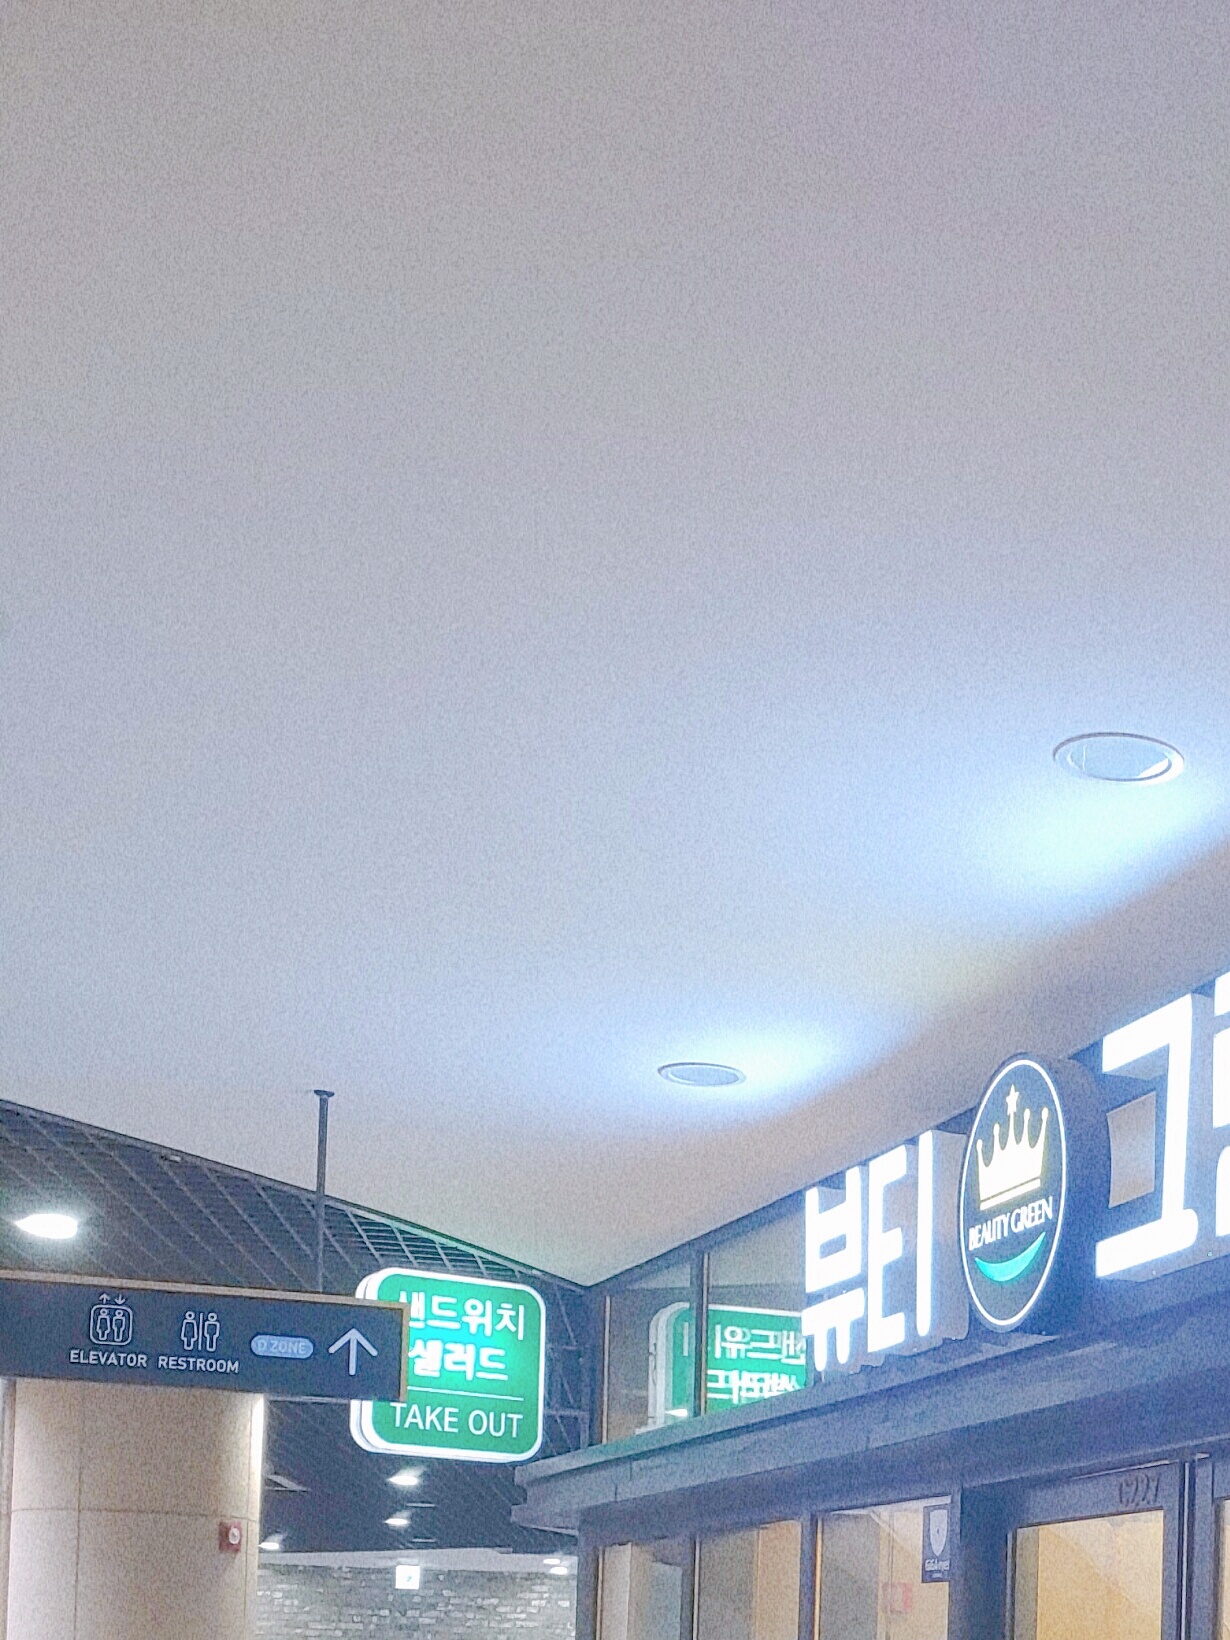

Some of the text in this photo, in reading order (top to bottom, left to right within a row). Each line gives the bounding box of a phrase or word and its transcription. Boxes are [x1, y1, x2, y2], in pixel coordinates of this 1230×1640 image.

[969, 1196, 1053, 1251] BEAUTY GREEN
[802, 1129, 933, 1369] 뷰티
[69, 1349, 148, 1369] ELEVATOR
[158, 1355, 240, 1374] RESTROOM
[257, 1338, 307, 1355] D ZONE
[408, 1339, 509, 1381] 샐러드
[390, 1402, 523, 1438] TAKE OUT
